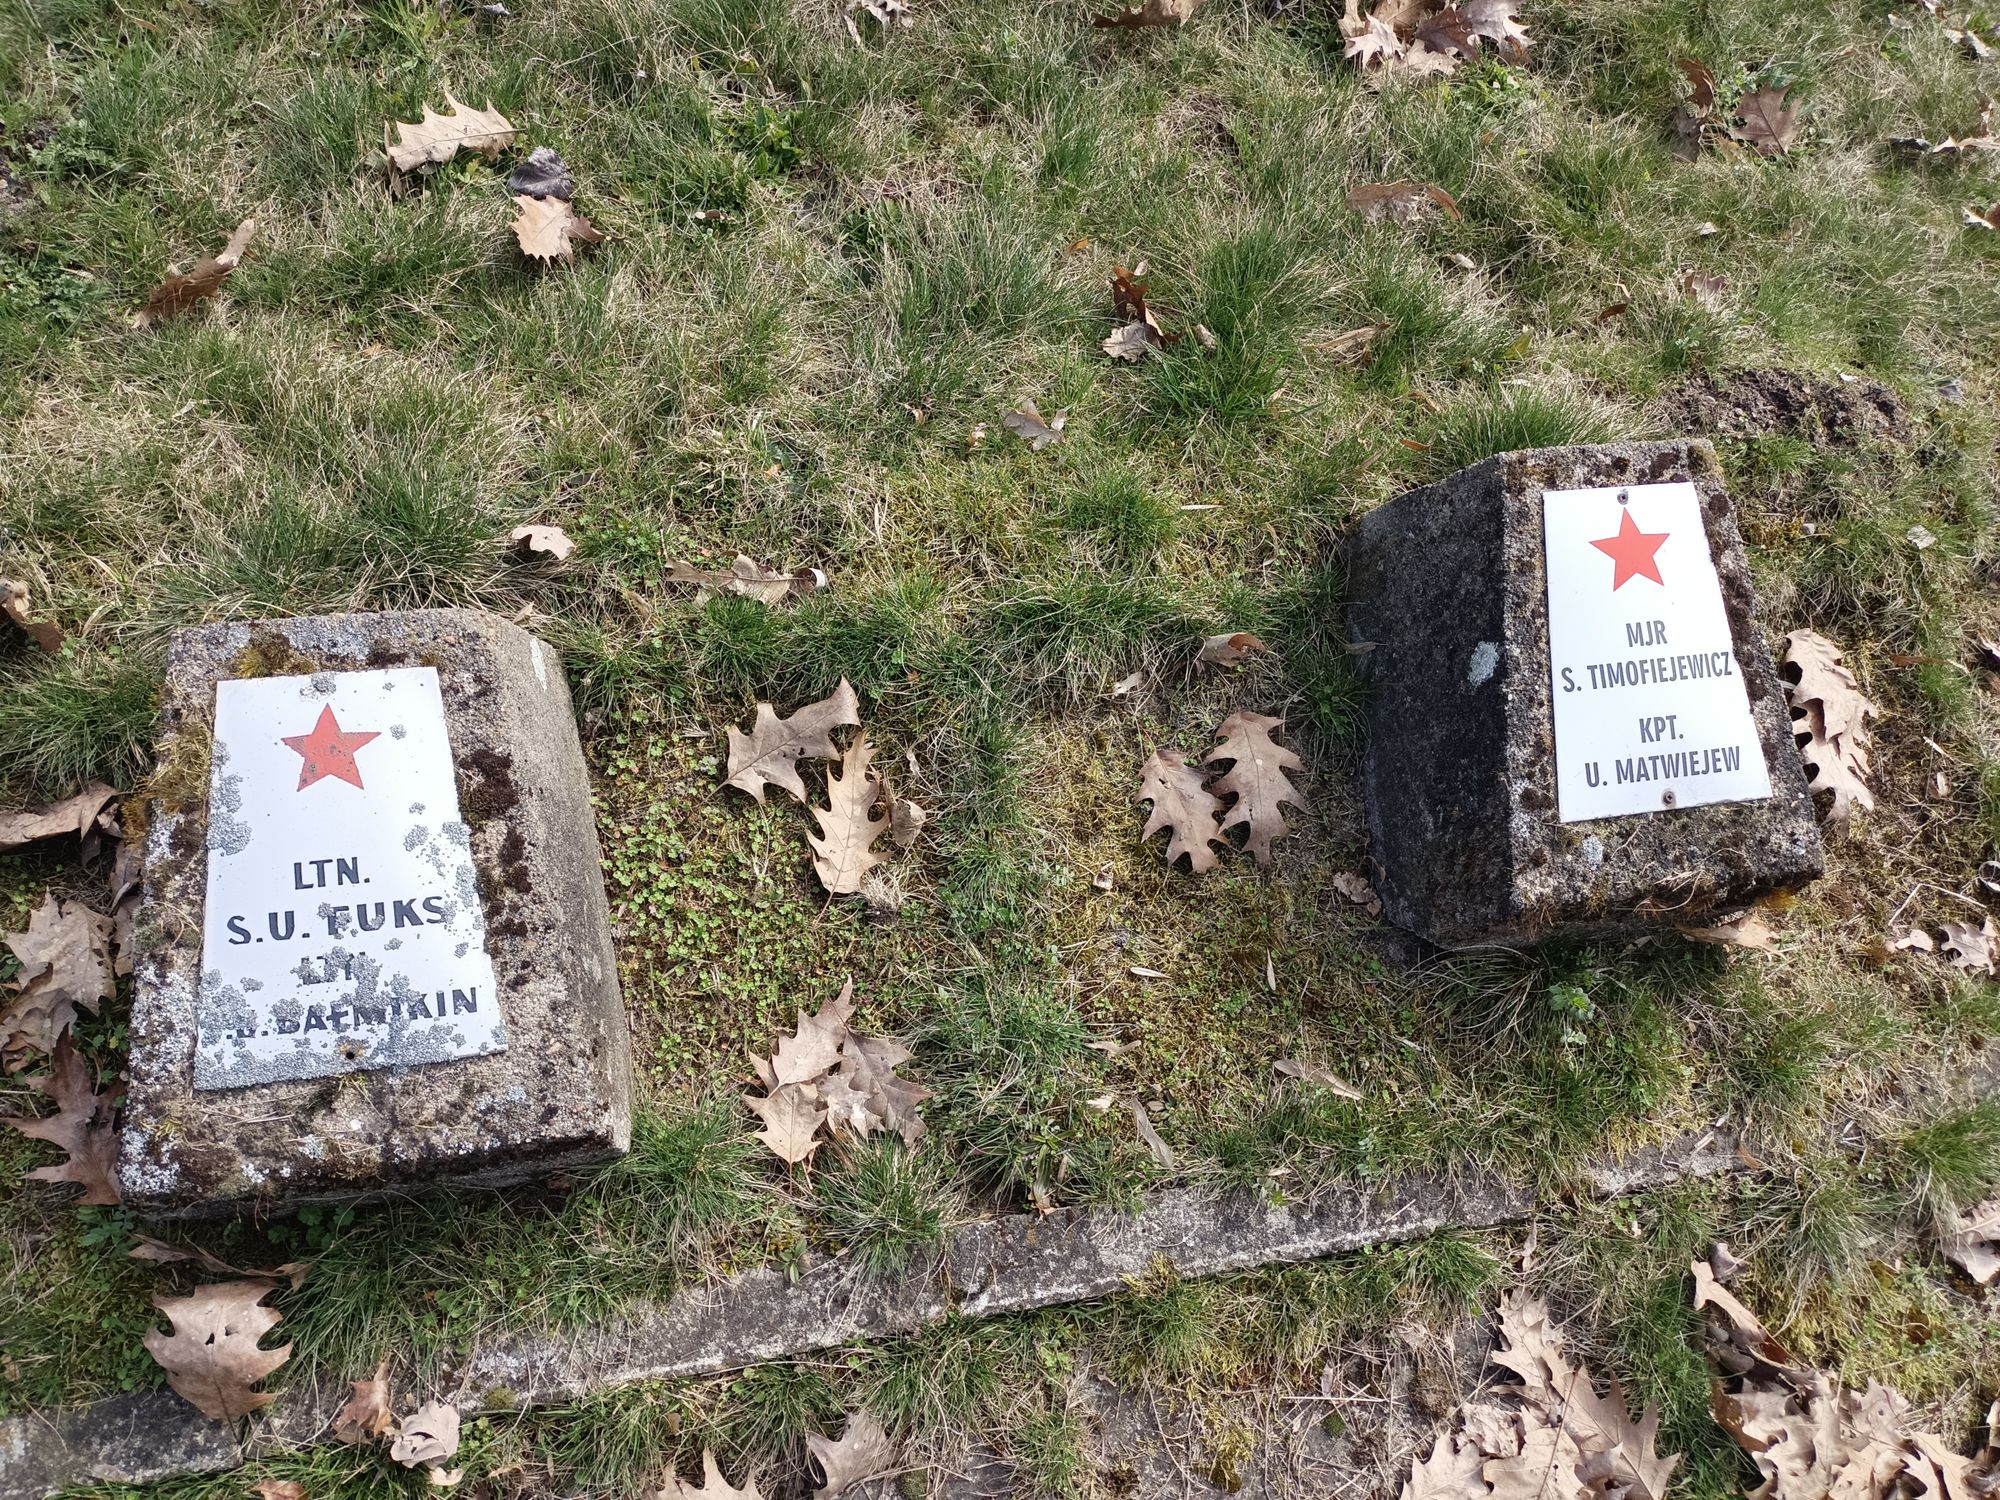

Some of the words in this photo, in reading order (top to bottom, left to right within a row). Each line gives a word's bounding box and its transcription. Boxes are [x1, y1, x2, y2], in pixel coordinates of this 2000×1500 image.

[1625, 620, 1668, 648] MJR
[1561, 666, 1583, 693] S.
[1586, 651, 1733, 690] TIMOFIEJEWICZ
[1638, 714, 1685, 743] KPT.
[1584, 761, 1608, 788] U.
[1614, 745, 1741, 785] MATWIEJEW
[293, 856, 371, 890] LTN.
[325, 895, 450, 936] FUKS
